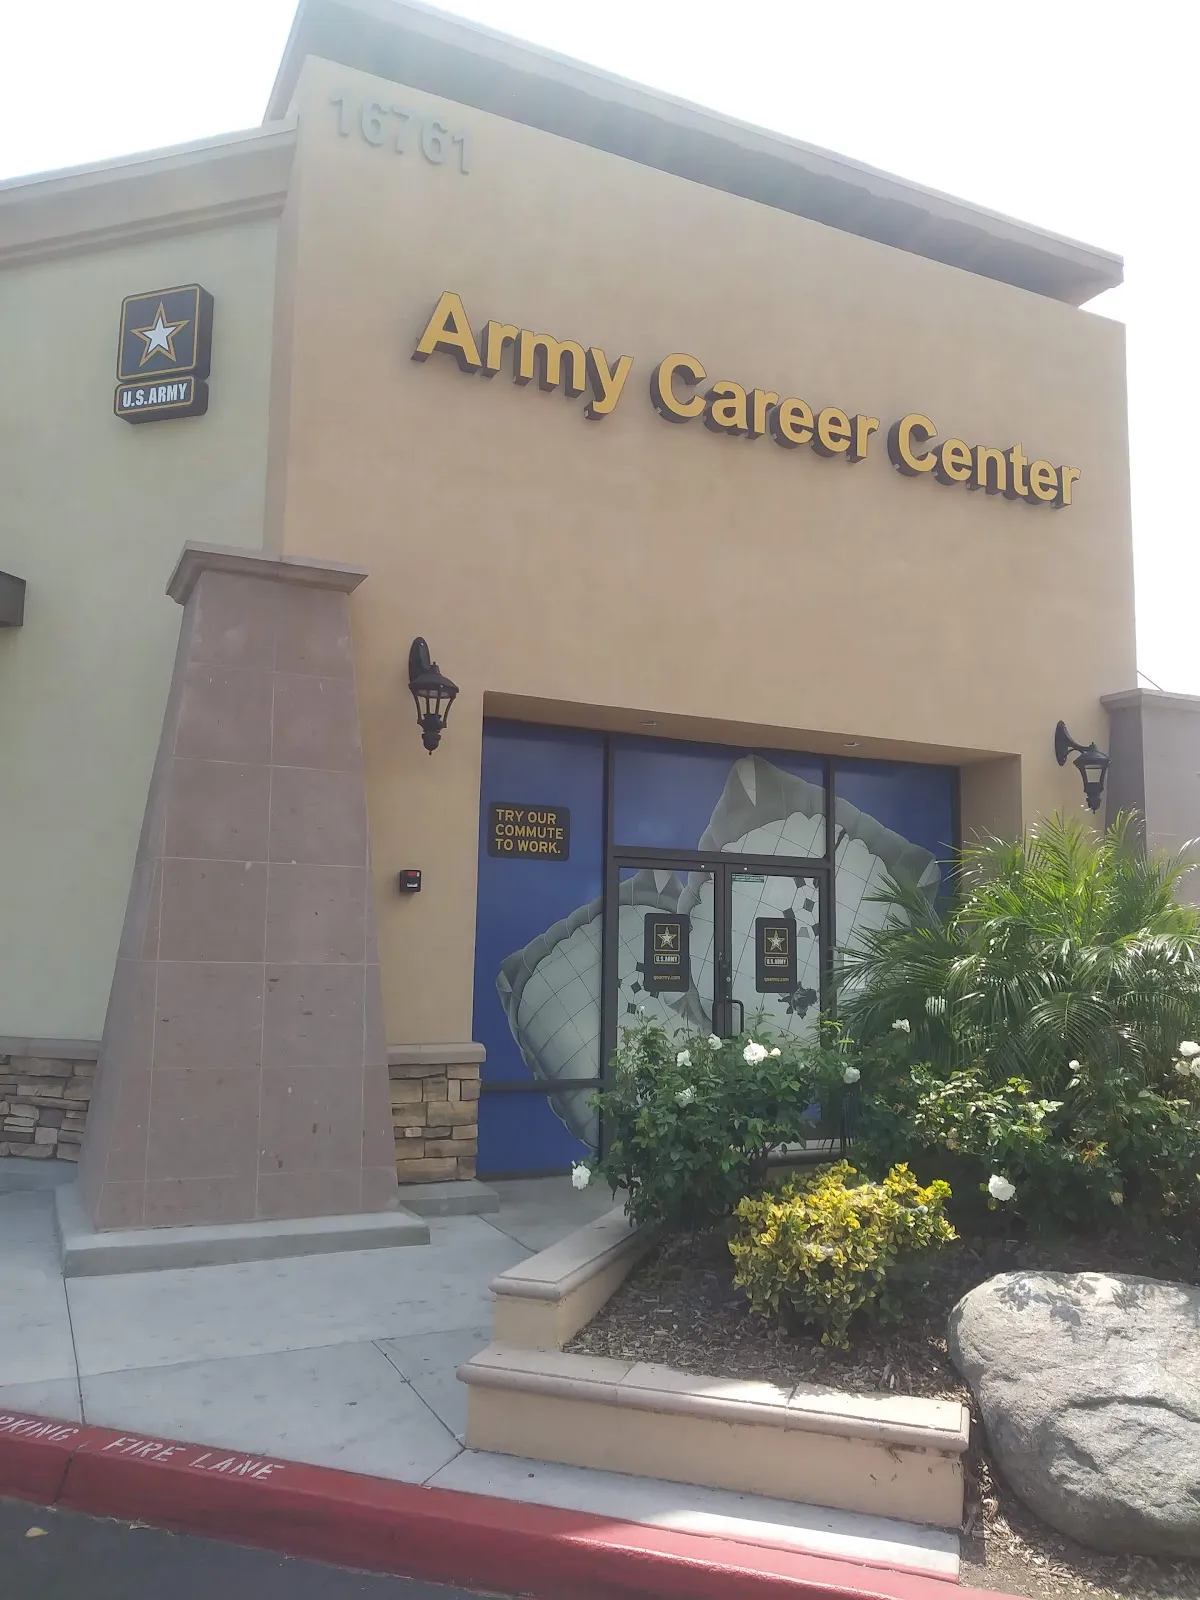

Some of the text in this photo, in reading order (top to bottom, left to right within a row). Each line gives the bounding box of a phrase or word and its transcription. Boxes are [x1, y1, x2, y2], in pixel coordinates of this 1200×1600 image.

[329, 92, 471, 175] 16761
[411, 290, 1081, 509] Army Career Center
[495, 808, 557, 825] TRY OUR
[495, 823, 564, 840] COMMUTE
[494, 838, 561, 854] TO WORK.
[101, 1437, 187, 1462] FIRE
[189, 1453, 286, 1480] LANE
